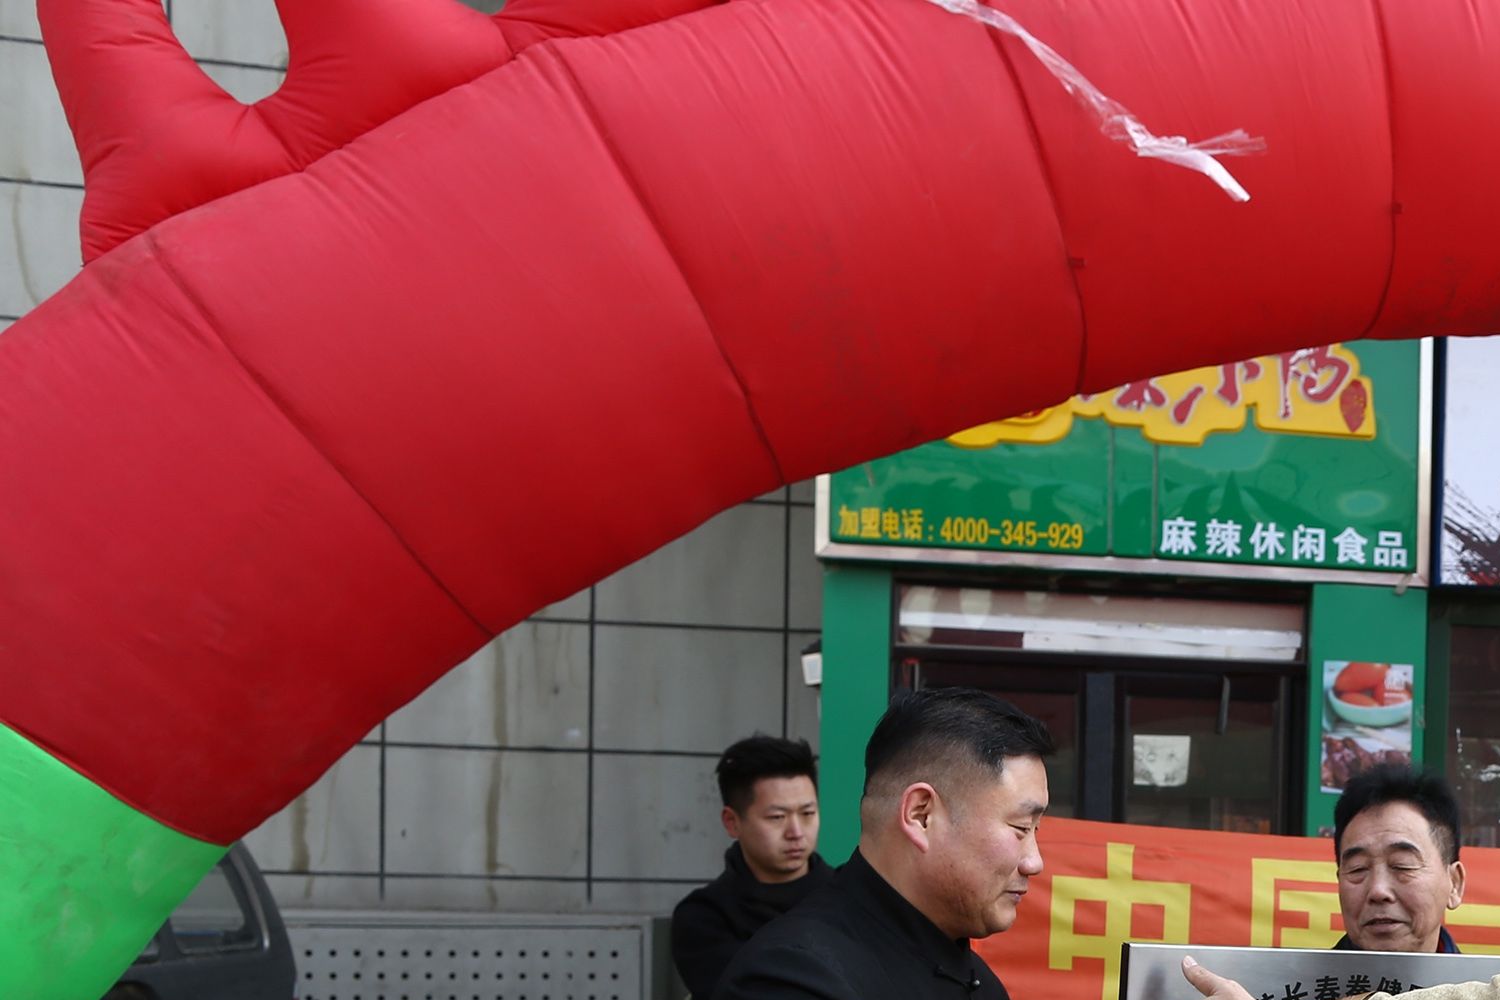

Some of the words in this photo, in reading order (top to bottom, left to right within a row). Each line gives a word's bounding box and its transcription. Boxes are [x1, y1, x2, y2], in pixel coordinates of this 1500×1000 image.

[1159, 516, 1408, 568] 麻辣休闲食品
